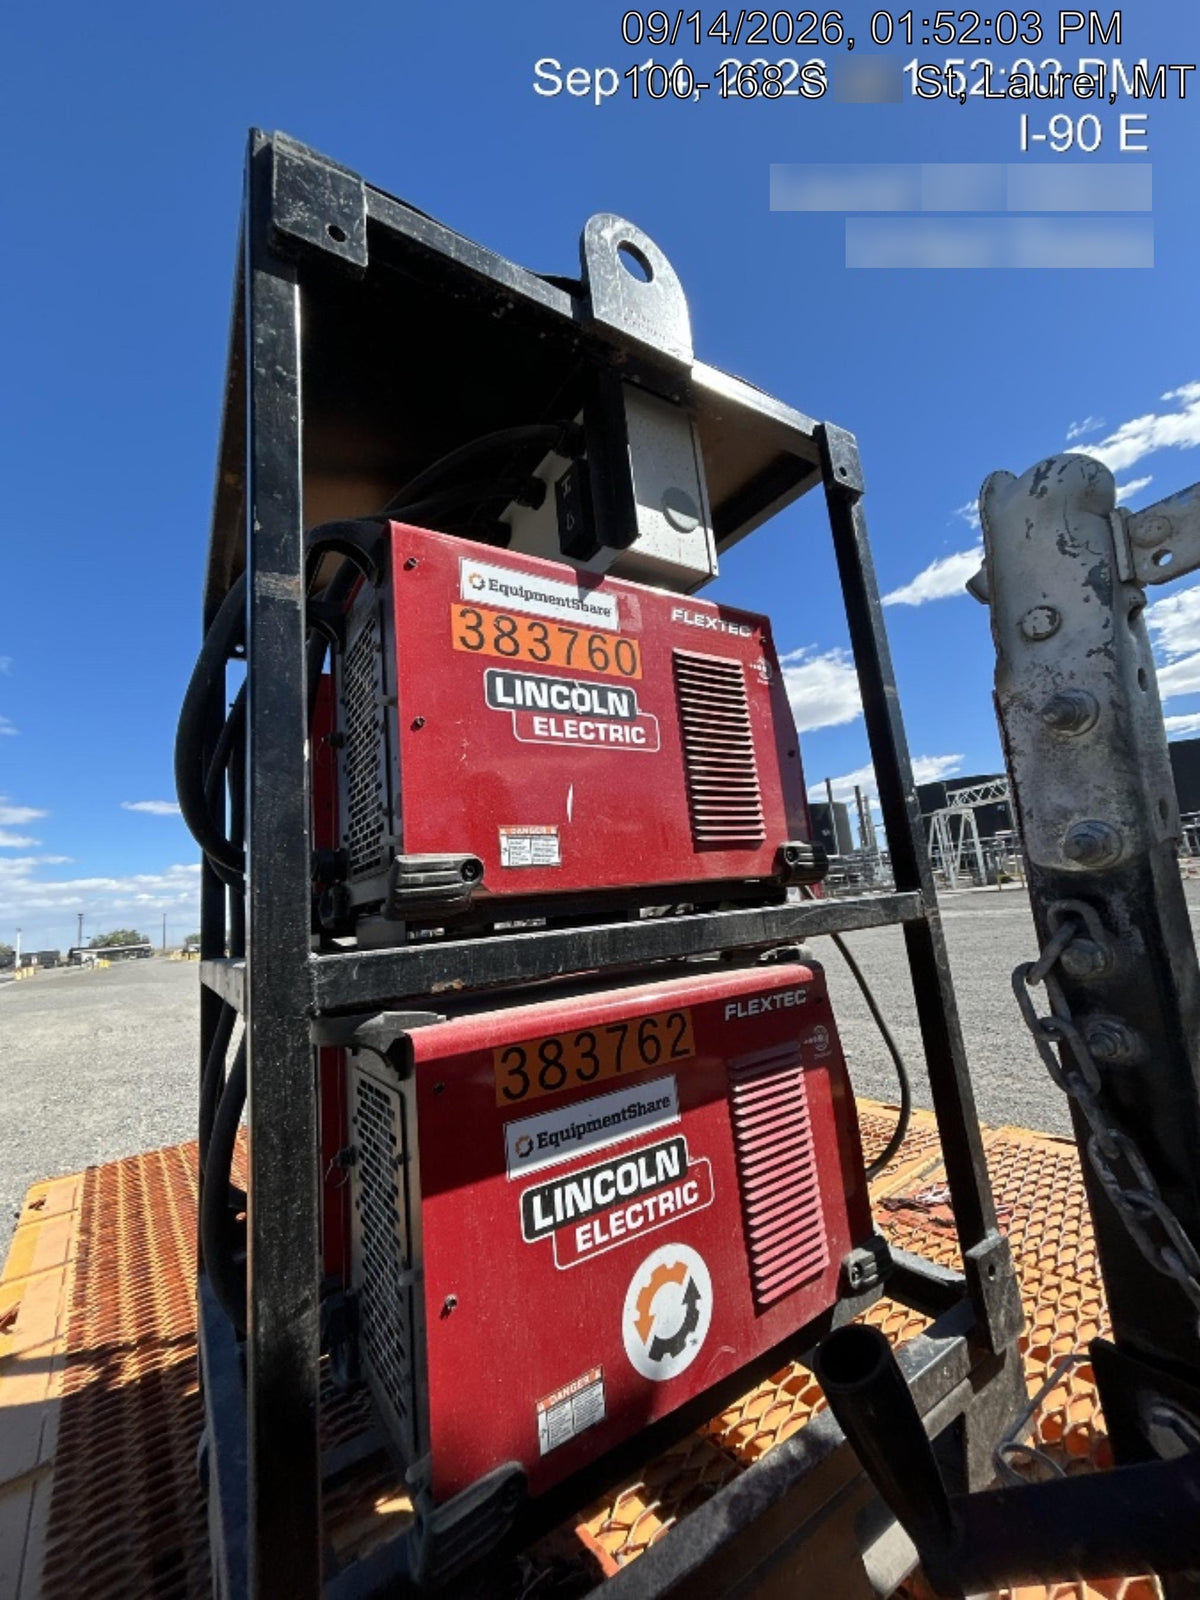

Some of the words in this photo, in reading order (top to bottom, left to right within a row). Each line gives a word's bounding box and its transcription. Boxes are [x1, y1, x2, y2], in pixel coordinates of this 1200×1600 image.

[488, 578, 612, 618] EquipmentShare
[459, 608, 638, 677] 383760
[671, 608, 752, 638] FLEXTEC
[495, 677, 629, 717] LINCOLN
[533, 716, 647, 744] ELECTRIC
[725, 989, 807, 1021] FLEXTEC
[501, 1012, 691, 1100] 383762
[536, 1095, 671, 1151] EquipmentShare
[533, 1146, 682, 1230] LINCOLN
[575, 1180, 699, 1253] ELECTRIC
